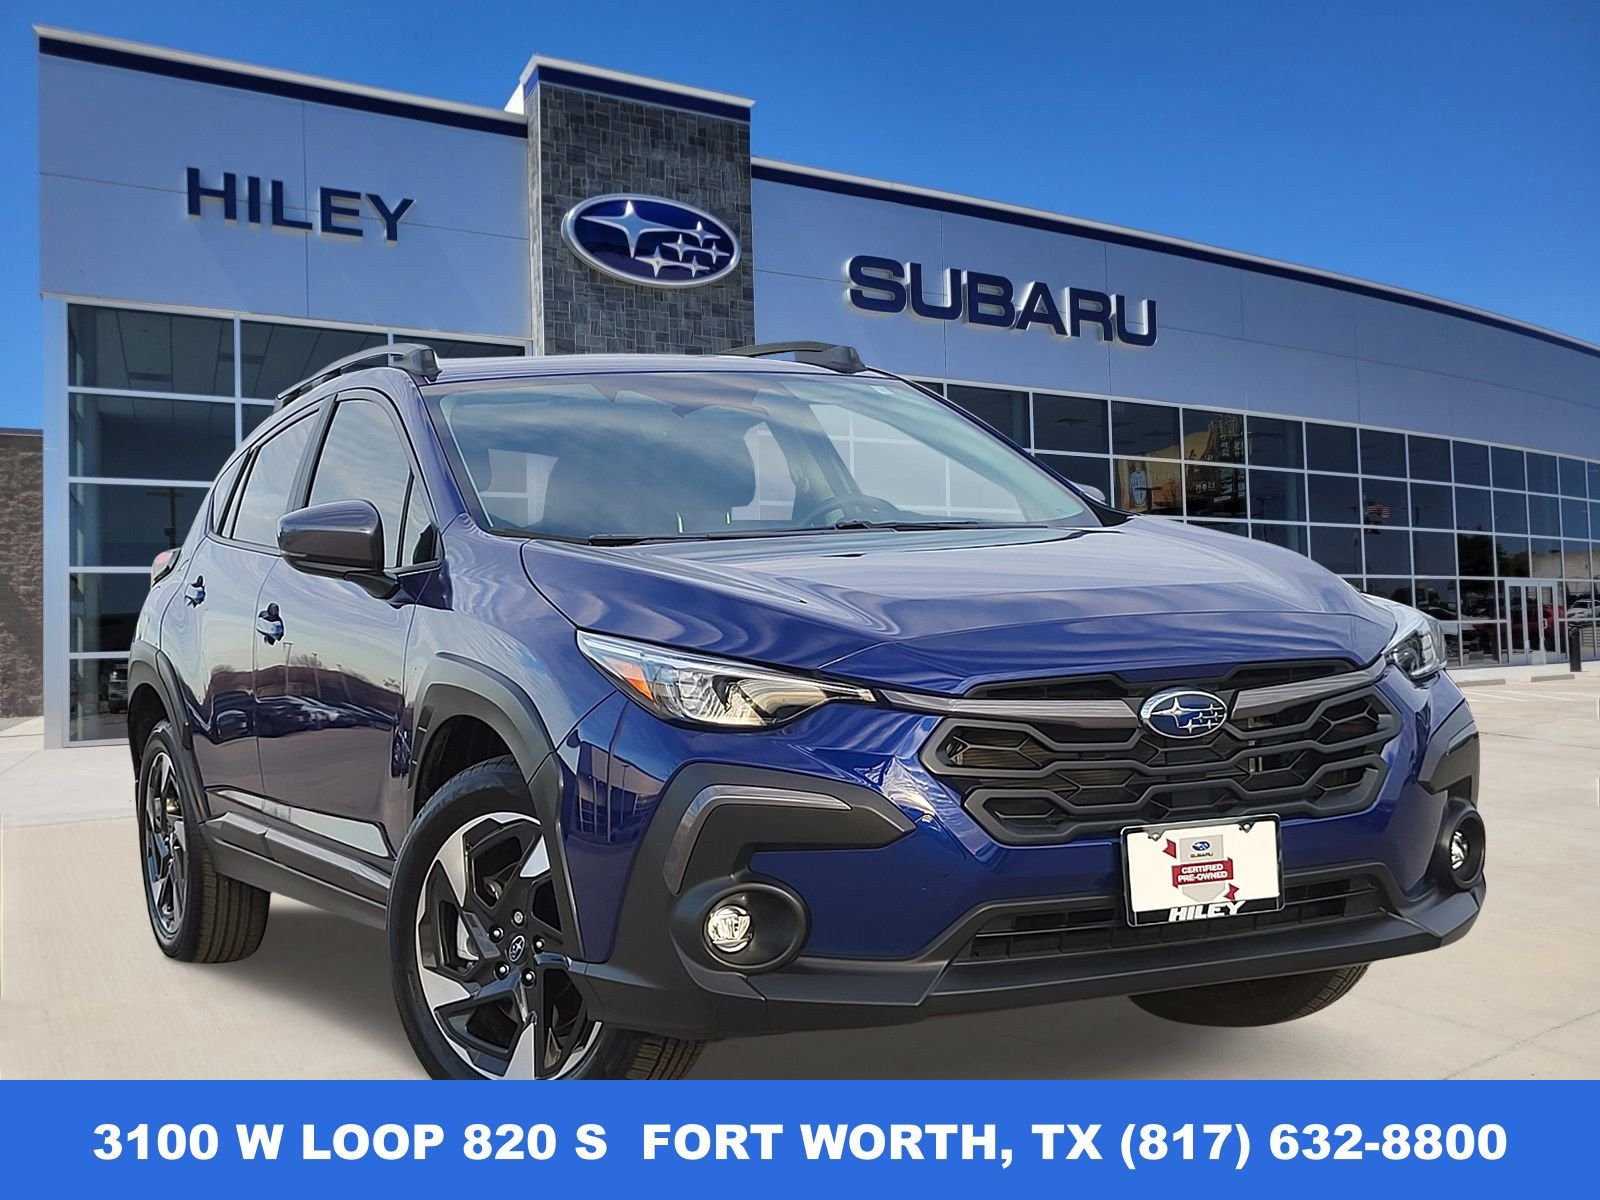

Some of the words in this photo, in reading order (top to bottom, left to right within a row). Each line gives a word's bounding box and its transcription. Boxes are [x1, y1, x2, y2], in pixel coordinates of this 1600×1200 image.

[186, 167, 416, 242] HILEY
[847, 254, 1158, 347] SUBARU
[1178, 871, 1227, 882] PRE-OWNED
[1181, 864, 1223, 873] CERTIFIED
[1168, 901, 1245, 922] HILEY
